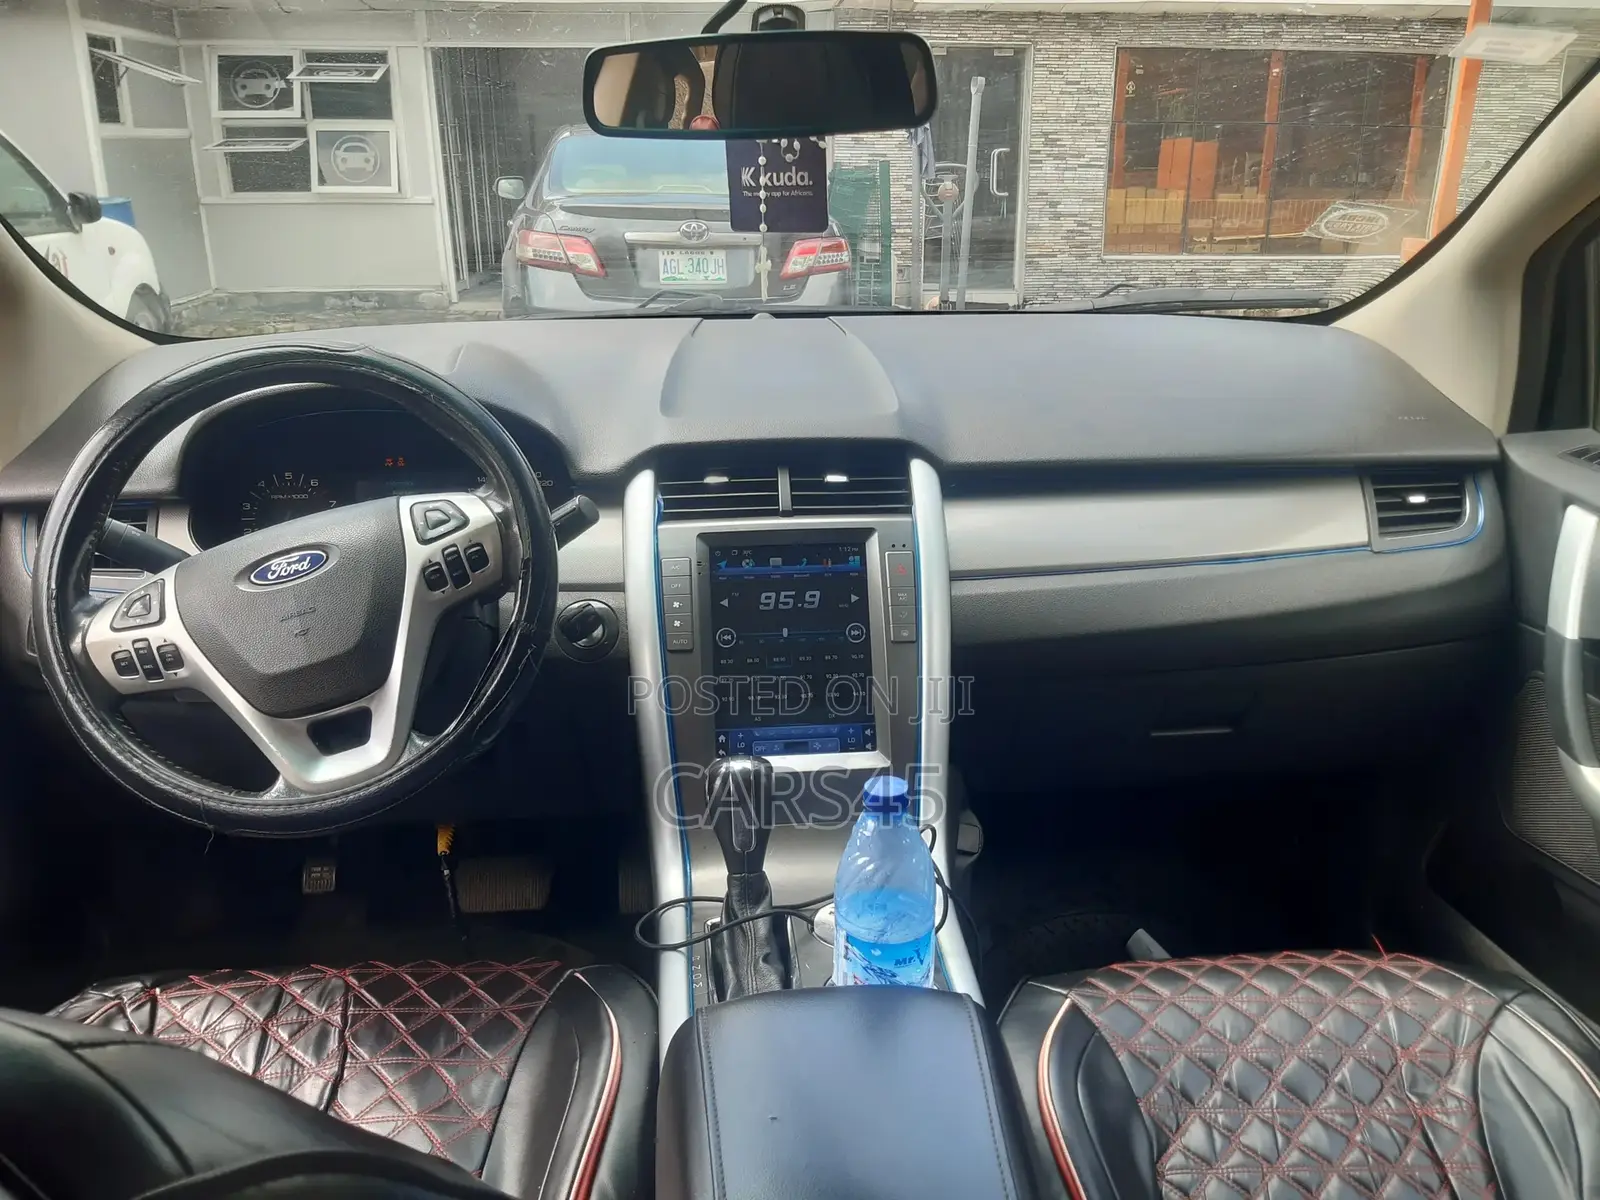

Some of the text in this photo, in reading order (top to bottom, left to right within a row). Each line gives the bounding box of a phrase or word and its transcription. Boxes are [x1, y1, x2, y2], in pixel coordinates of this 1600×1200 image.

[285, 472, 293, 480] 5
[310, 479, 319, 487] 6
[242, 502, 251, 510] 3
[328, 500, 337, 508] 7
[267, 556, 311, 580] Ford
[759, 590, 821, 611] 95.9
